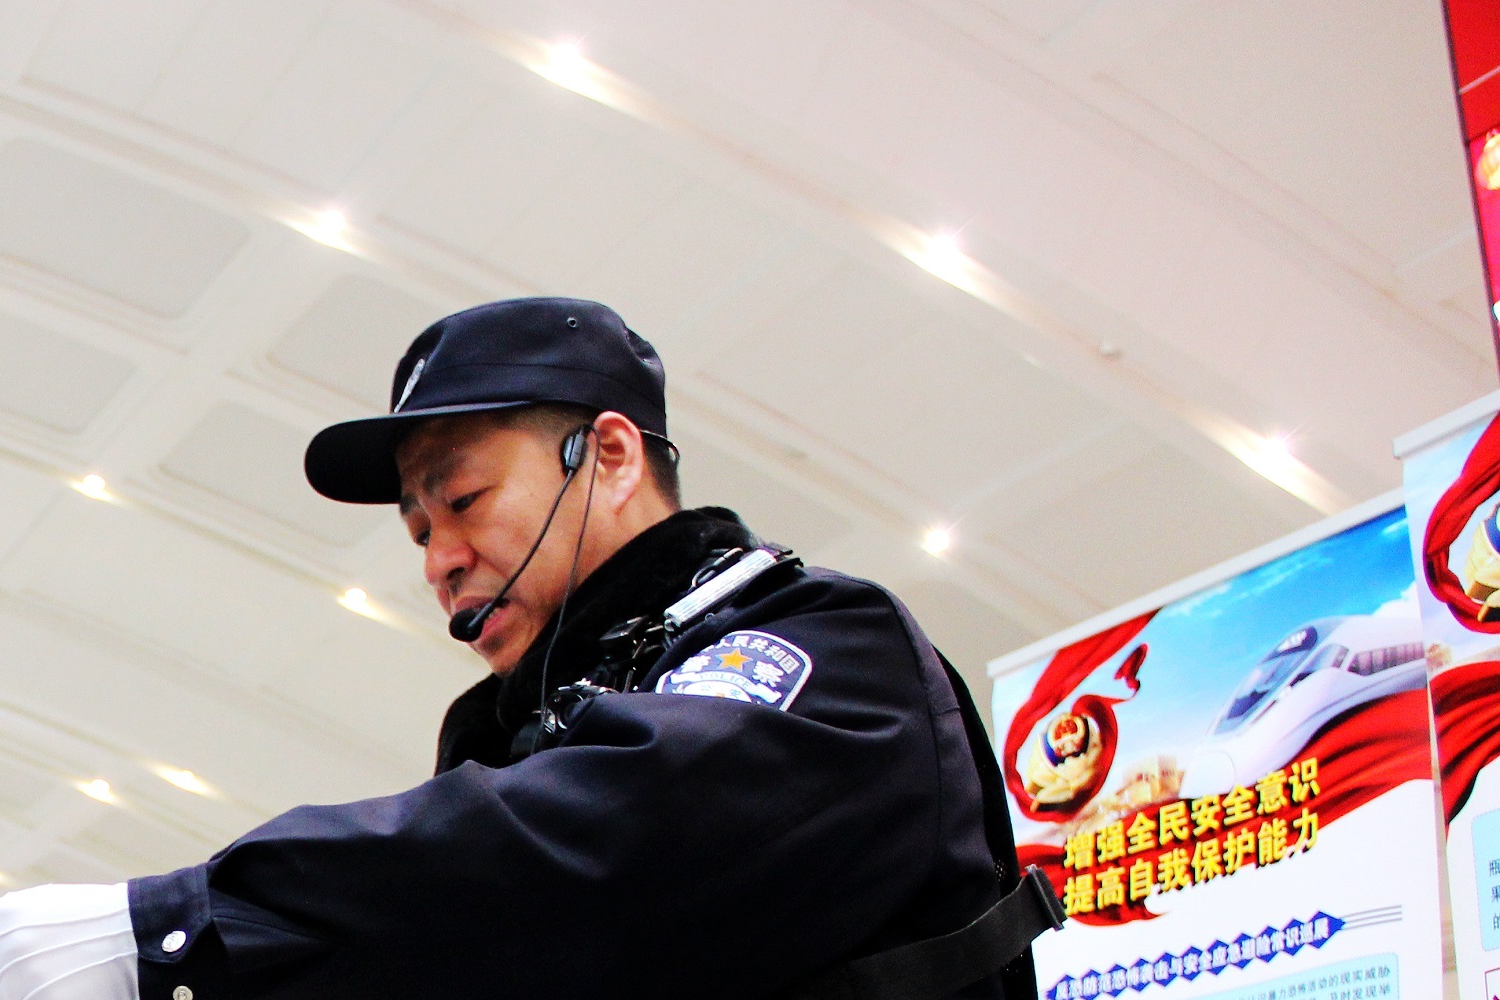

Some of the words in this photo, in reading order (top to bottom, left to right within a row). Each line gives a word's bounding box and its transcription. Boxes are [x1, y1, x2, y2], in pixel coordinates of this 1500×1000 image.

[701, 672, 753, 691] POLICE
[1063, 757, 1321, 870] 增强全民安全意识
[1063, 807, 1320, 916] 提高自我保护能力
